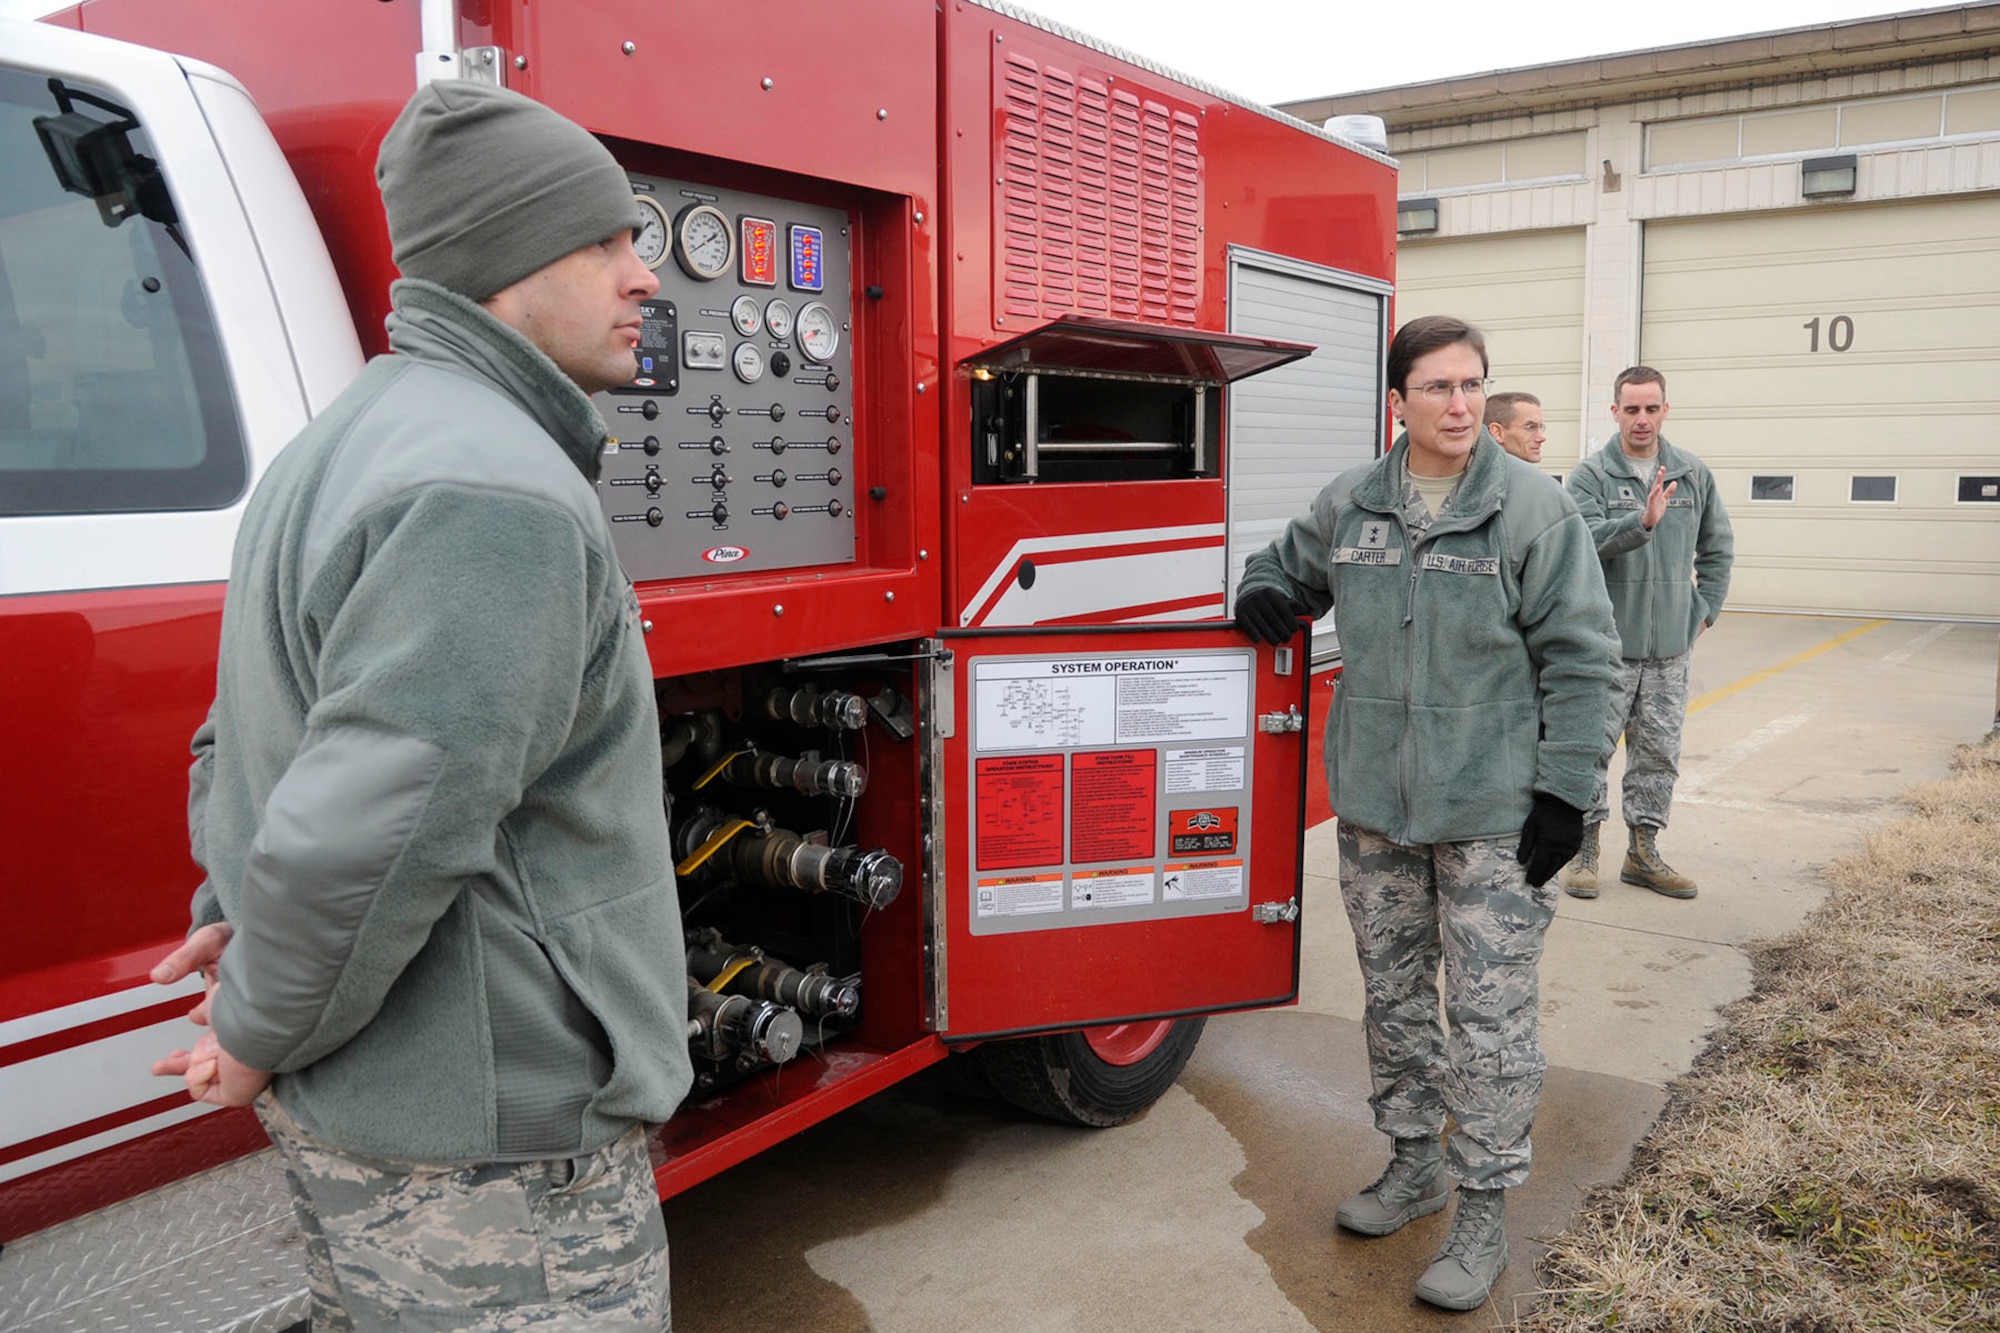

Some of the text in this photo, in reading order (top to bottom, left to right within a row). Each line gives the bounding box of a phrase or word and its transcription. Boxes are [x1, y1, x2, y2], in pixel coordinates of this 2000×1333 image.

[1803, 315, 1854, 353] 10
[713, 548, 740, 560] Pierce
[1350, 550, 1386, 563] CARTER
[1427, 554, 1495, 573] U.S. AIR FORCE
[1051, 662, 1101, 674] SYSTEM
